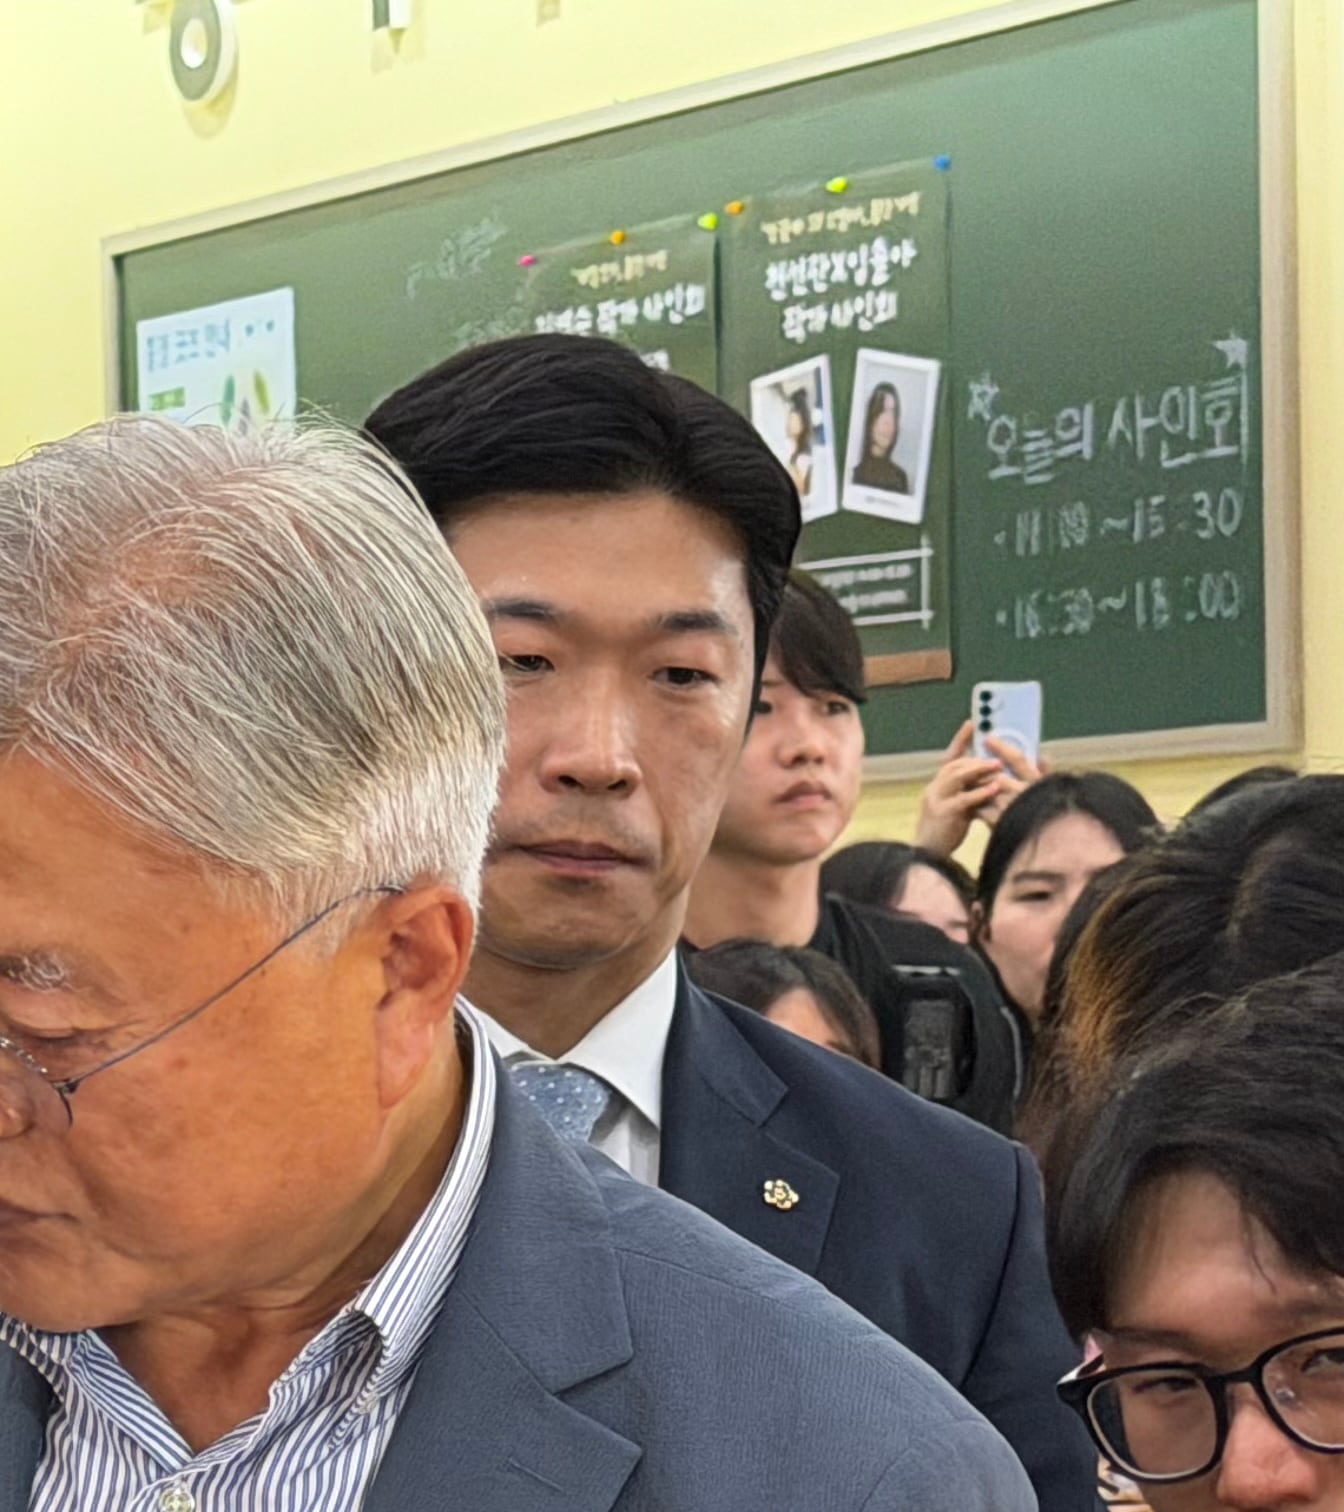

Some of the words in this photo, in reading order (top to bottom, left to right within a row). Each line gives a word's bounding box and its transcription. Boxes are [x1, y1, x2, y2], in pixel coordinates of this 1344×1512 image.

[831, 290, 898, 332] 사인회
[987, 402, 1093, 484] 오늘의
[1108, 370, 1248, 470] 사인회
